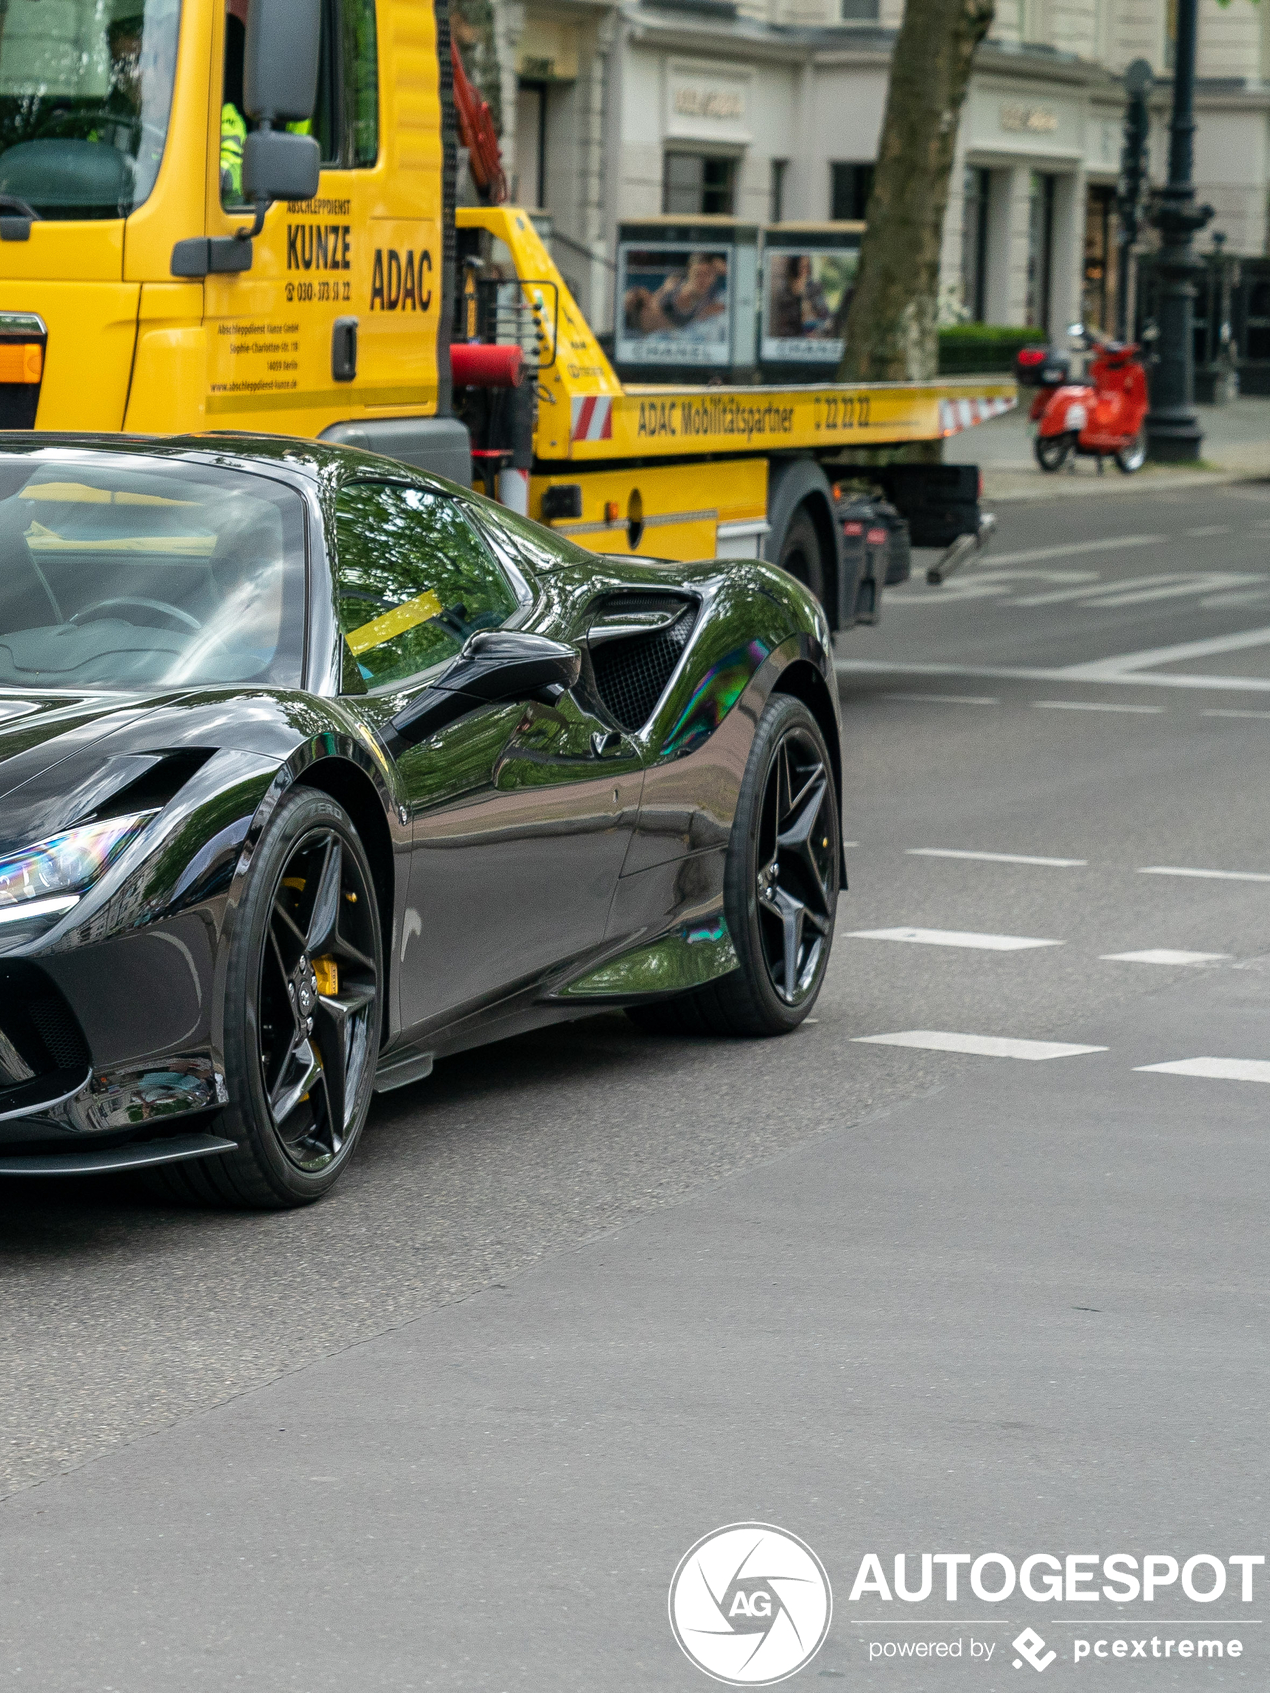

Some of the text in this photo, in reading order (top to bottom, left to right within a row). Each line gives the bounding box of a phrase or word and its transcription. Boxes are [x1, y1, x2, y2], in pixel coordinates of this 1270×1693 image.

[286, 199, 351, 216] ABSCHLEPPDIENST
[286, 225, 351, 270] KUNZE
[369, 248, 432, 312] ADAC
[637, 401, 677, 437] ADAC
[681, 396, 795, 443] Mobilitätspartner
